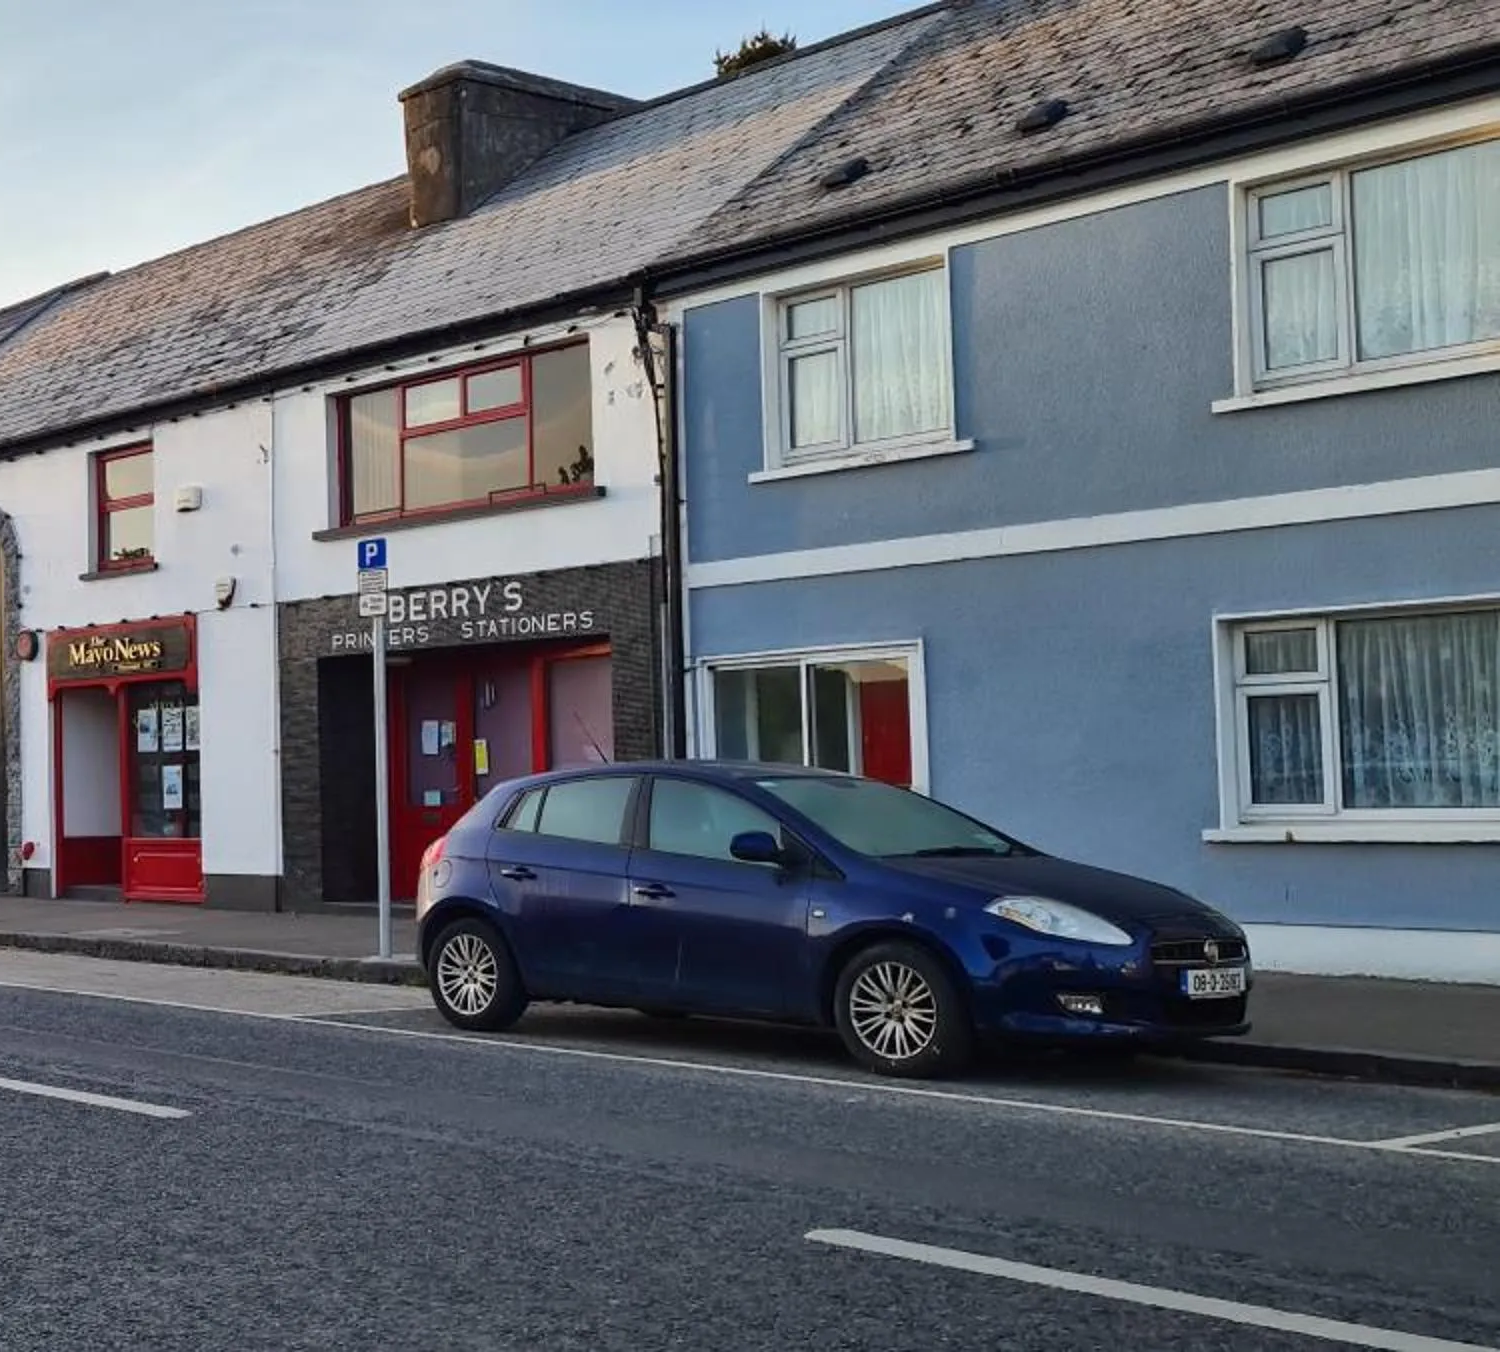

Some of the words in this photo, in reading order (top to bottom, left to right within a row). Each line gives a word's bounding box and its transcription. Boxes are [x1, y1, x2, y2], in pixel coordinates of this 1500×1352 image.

[365, 543, 378, 567] P
[389, 582, 523, 623] BERRY'S
[331, 626, 430, 650] PRINERS
[461, 611, 594, 639] STATIONERS
[69, 642, 113, 668] Mayo
[113, 637, 161, 661] News
